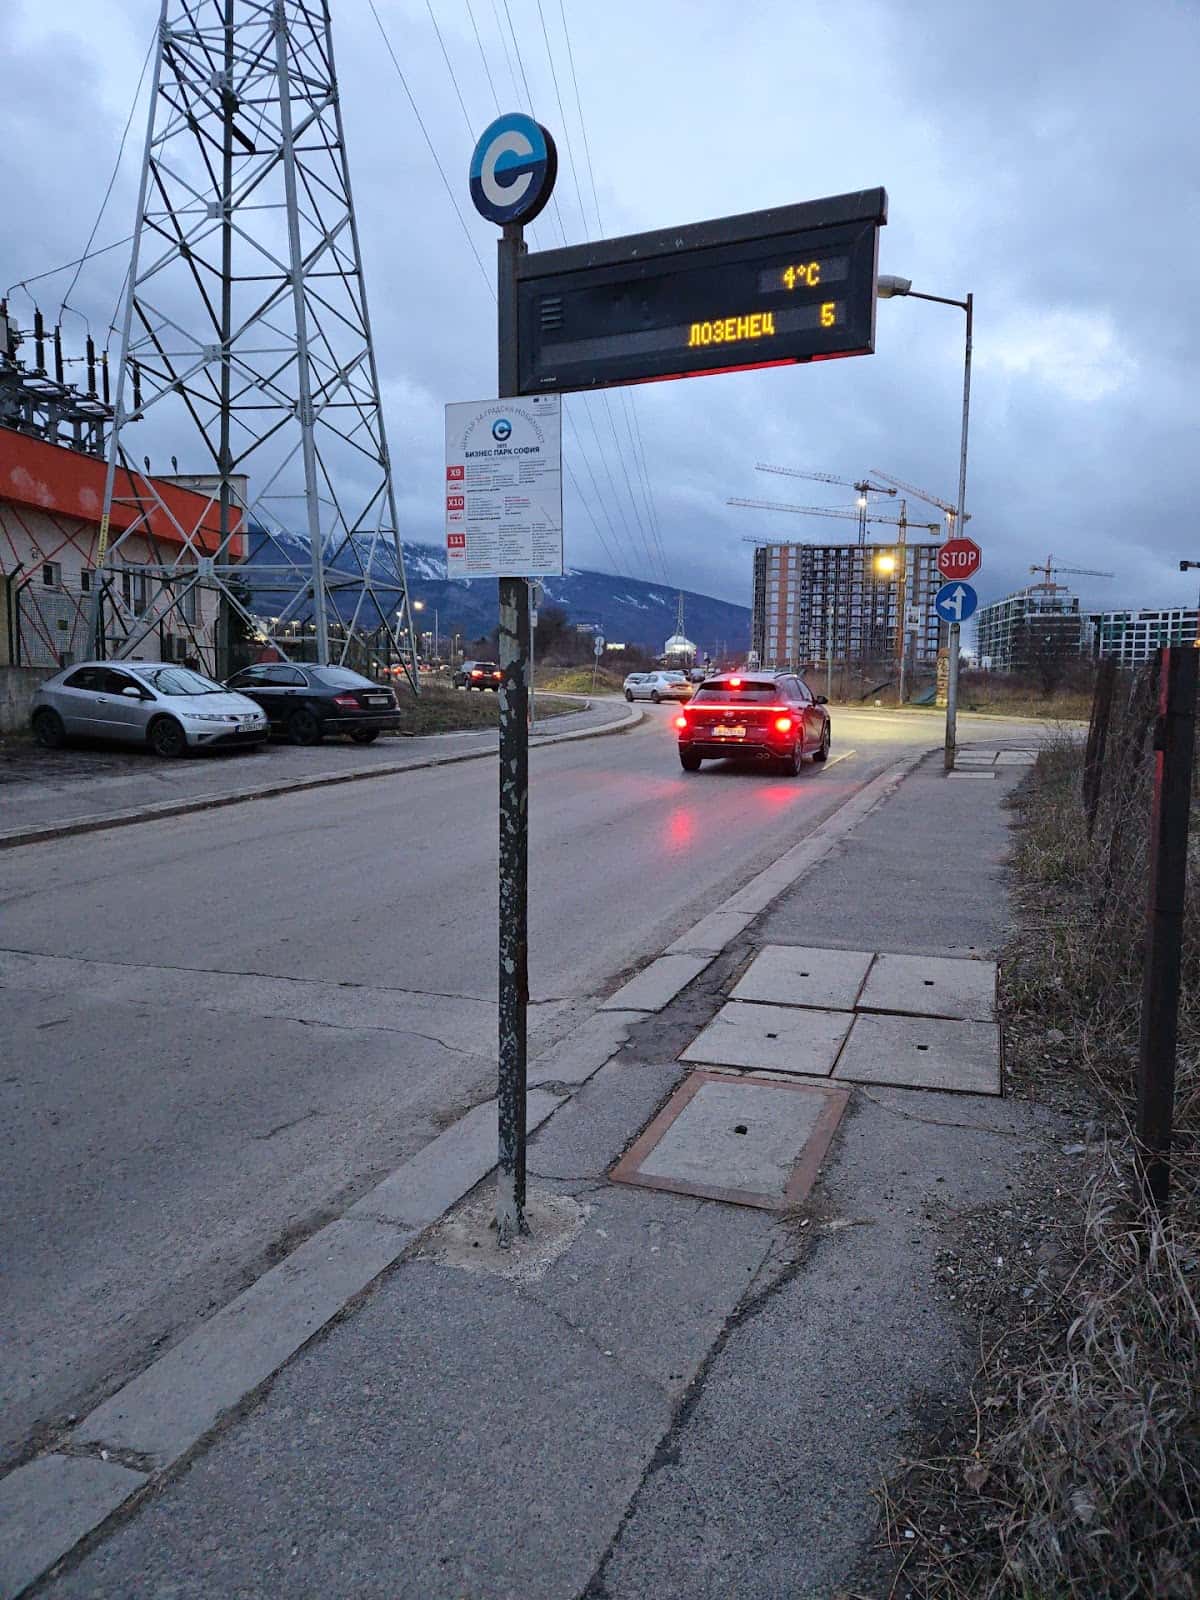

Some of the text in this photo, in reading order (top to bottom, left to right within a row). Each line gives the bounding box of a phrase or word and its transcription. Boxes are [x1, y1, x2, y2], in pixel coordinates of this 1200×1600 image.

[783, 262, 820, 290] 4°C
[688, 302, 835, 347] ЛОЗЕНЕЦ 5
[465, 449, 493, 458] БИЗНЕС
[494, 447, 512, 456] ПАРК
[513, 446, 540, 454] СОФИЯ
[941, 551, 976, 567] STOP
